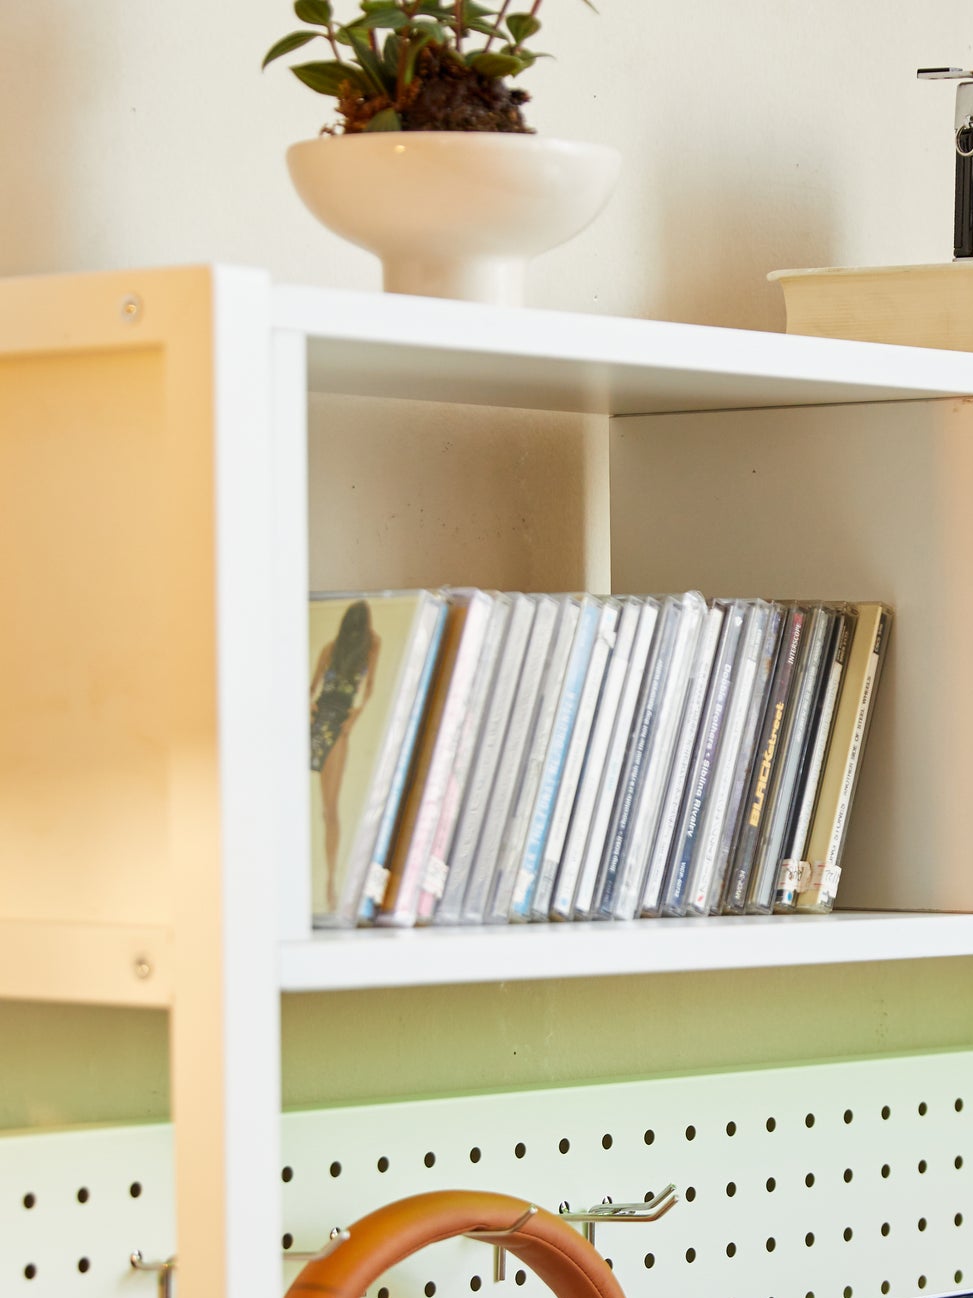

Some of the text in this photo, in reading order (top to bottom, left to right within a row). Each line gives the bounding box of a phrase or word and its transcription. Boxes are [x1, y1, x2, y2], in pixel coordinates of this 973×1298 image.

[786, 624, 801, 665] INTERSCOPE
[861, 676, 871, 704] WHEELS
[707, 703, 723, 750] Brothers
[696, 758, 710, 797] Sibling
[747, 701, 785, 826] BLACKstreet
[686, 798, 702, 837] Rivalry
